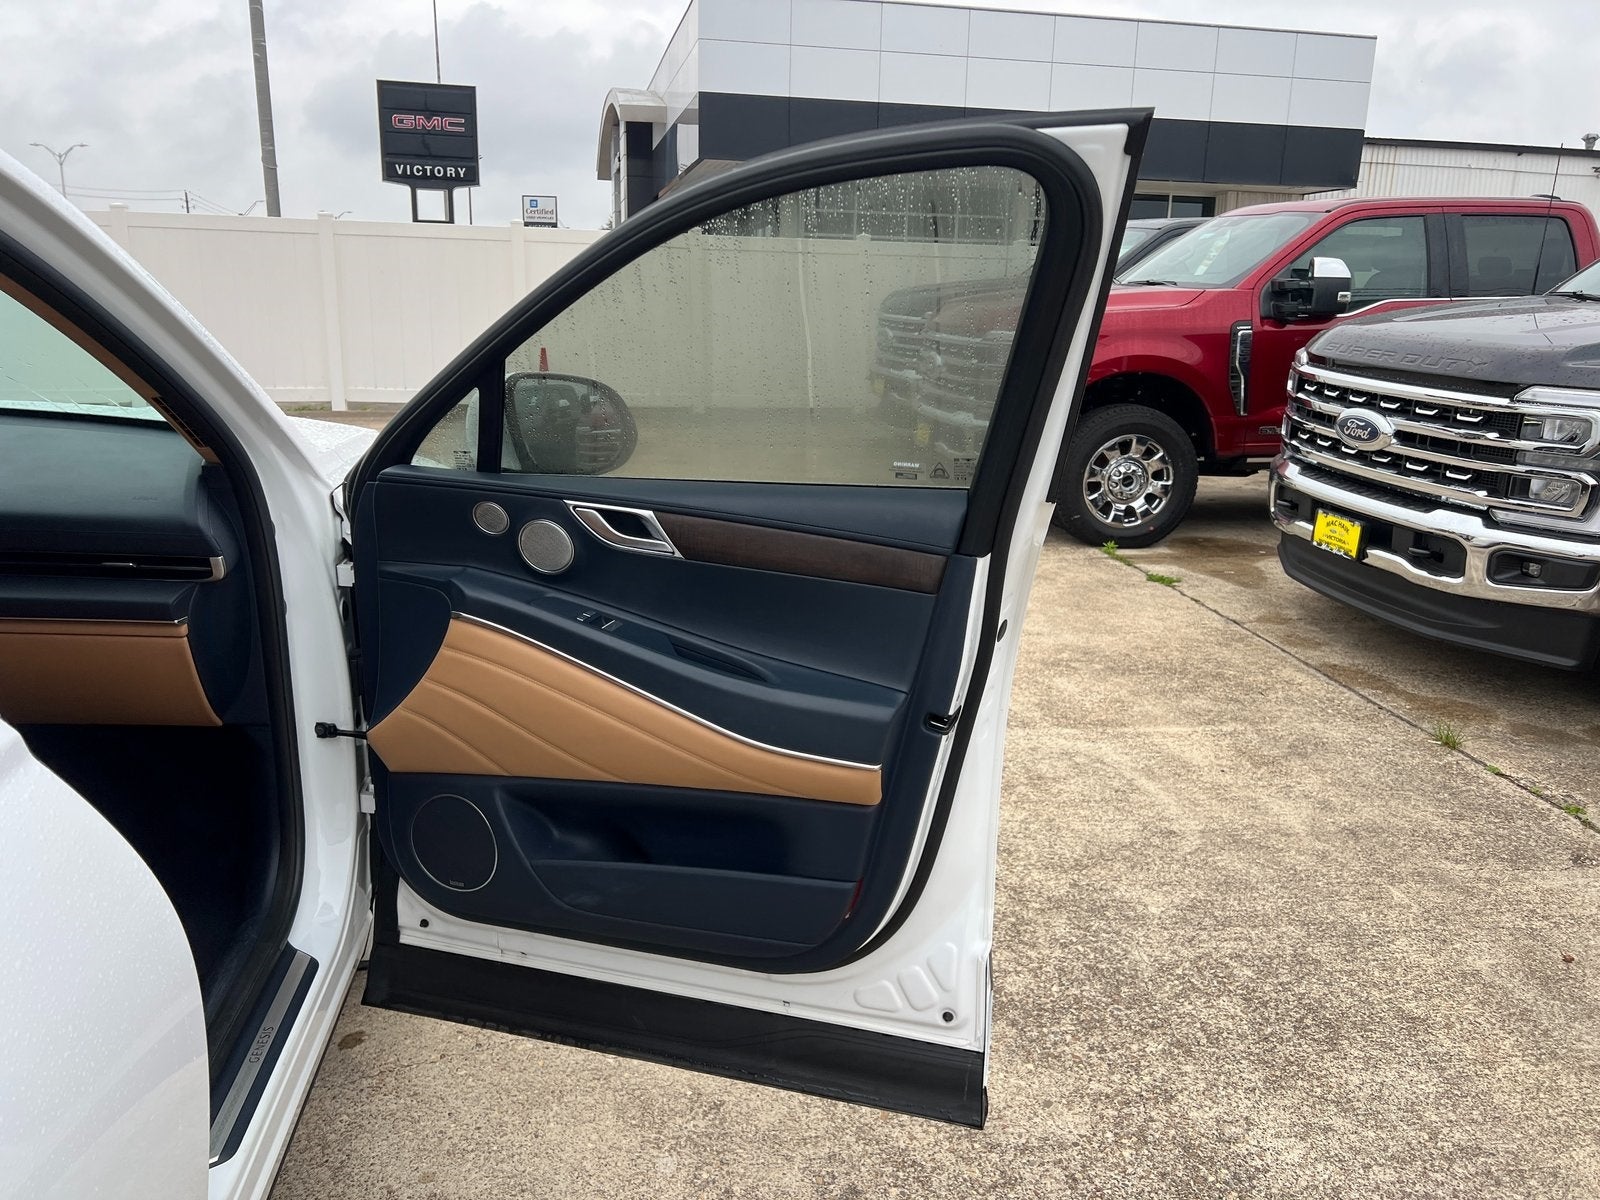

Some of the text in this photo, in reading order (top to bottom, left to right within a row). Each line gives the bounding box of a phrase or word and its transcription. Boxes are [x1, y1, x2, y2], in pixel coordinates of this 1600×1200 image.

[391, 114, 465, 132] GMC
[395, 164, 466, 178] VICTORY
[525, 208, 554, 216] Certified
[1323, 342, 1490, 374] SUPER DUTY
[1343, 419, 1372, 441] Ford
[248, 1026, 274, 1063] GENESIS
